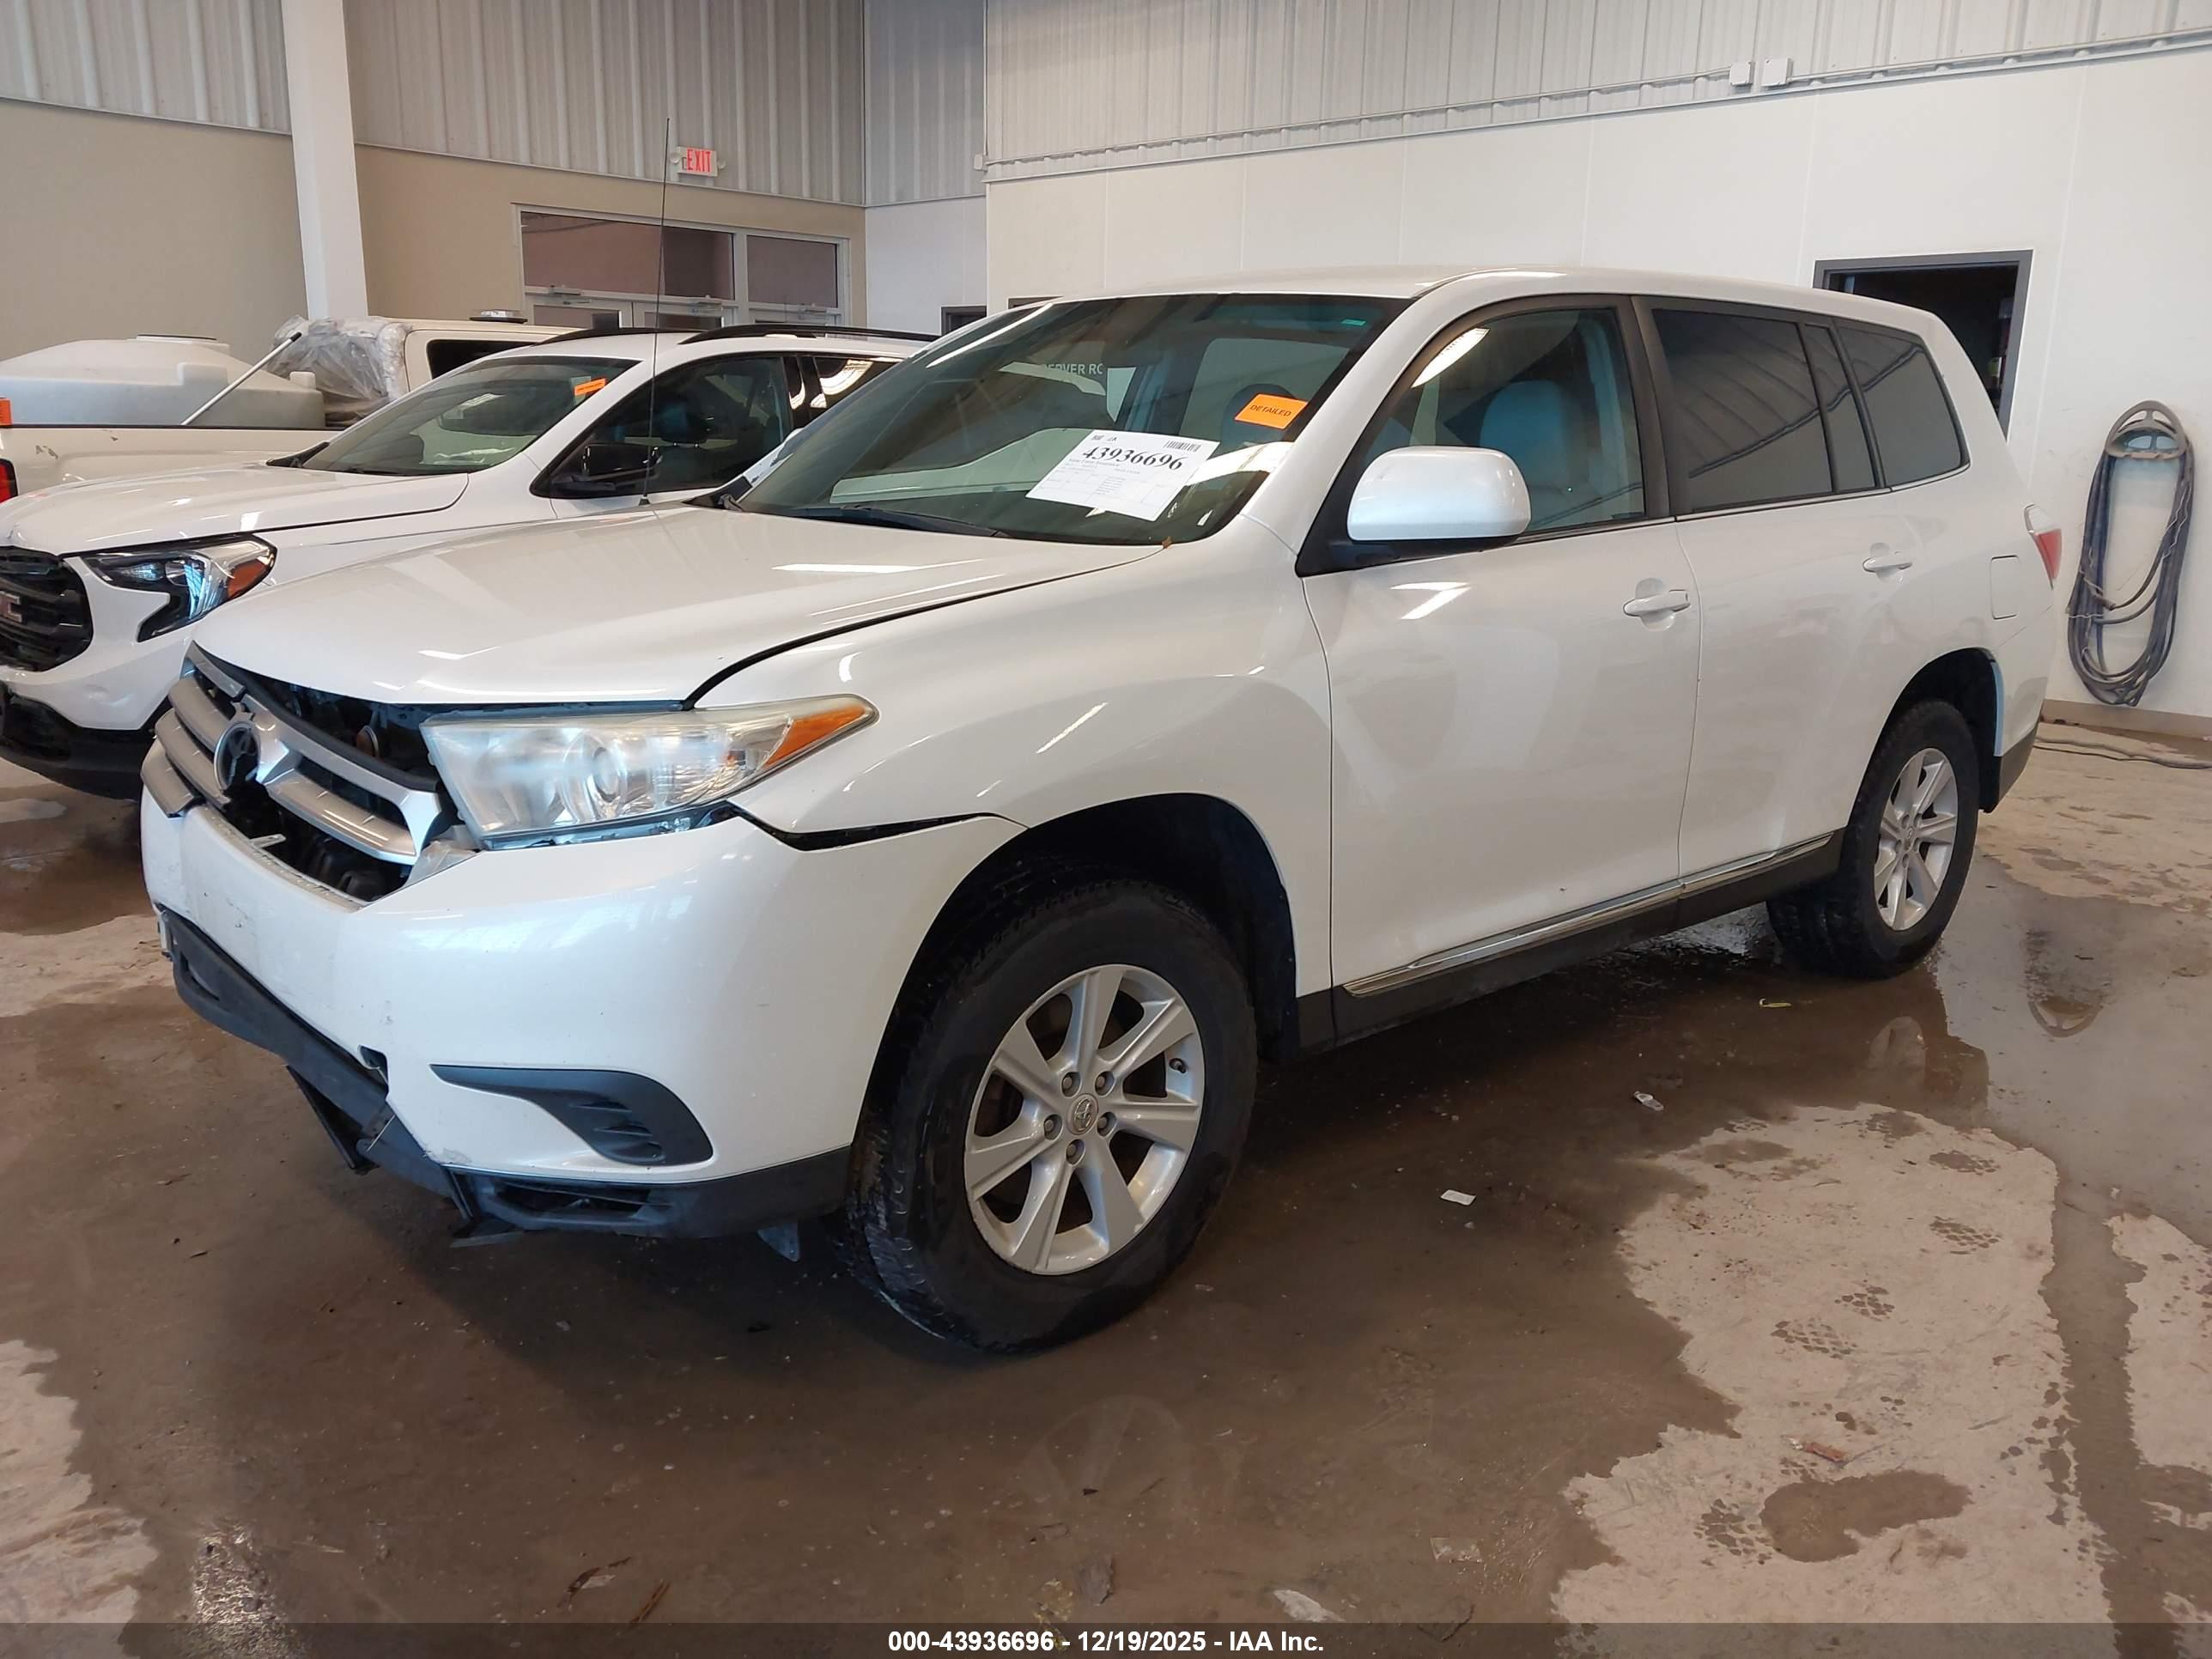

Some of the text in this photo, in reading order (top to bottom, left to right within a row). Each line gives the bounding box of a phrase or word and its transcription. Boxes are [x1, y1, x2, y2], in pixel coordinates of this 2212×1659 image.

[687, 149, 711, 172] EXIT
[1249, 404, 1292, 417] DETAILED
[1082, 446, 1189, 471] 43936696
